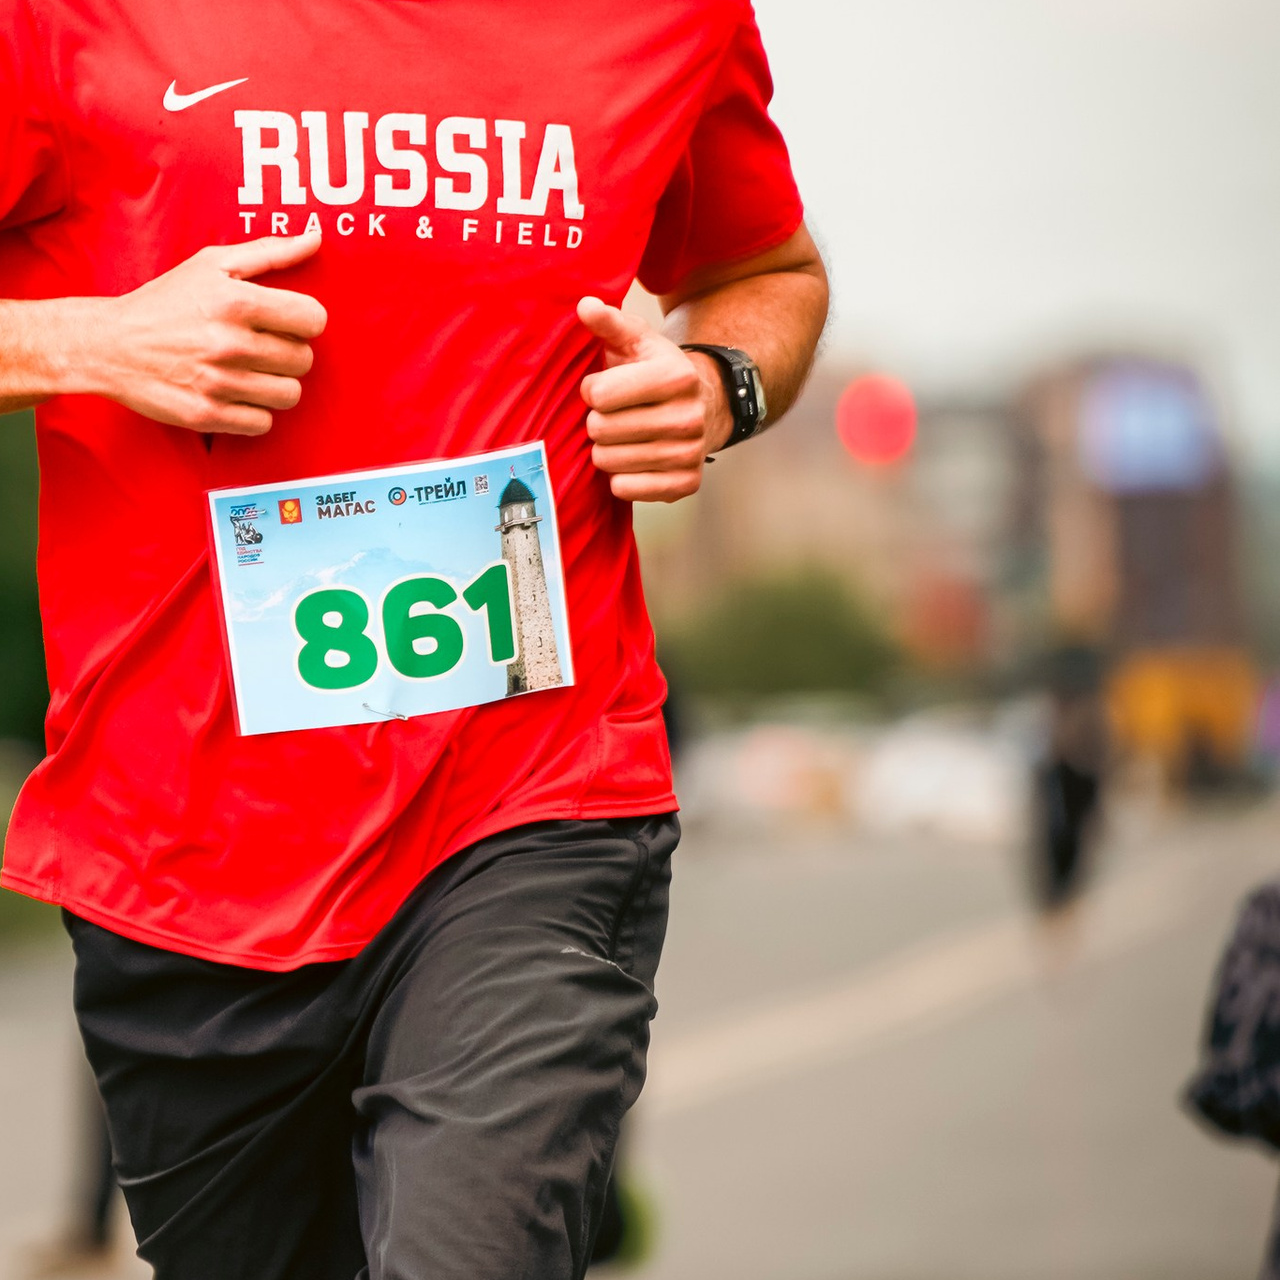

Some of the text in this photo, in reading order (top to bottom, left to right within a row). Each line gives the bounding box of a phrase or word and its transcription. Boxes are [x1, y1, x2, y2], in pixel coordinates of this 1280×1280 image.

[234, 109, 585, 220] RUSSIA
[238, 211, 583, 249] TRACK & FIELD
[315, 491, 357, 506] ЗАБЕГ
[317, 500, 377, 520] МАГАС
[294, 563, 516, 691] 861
